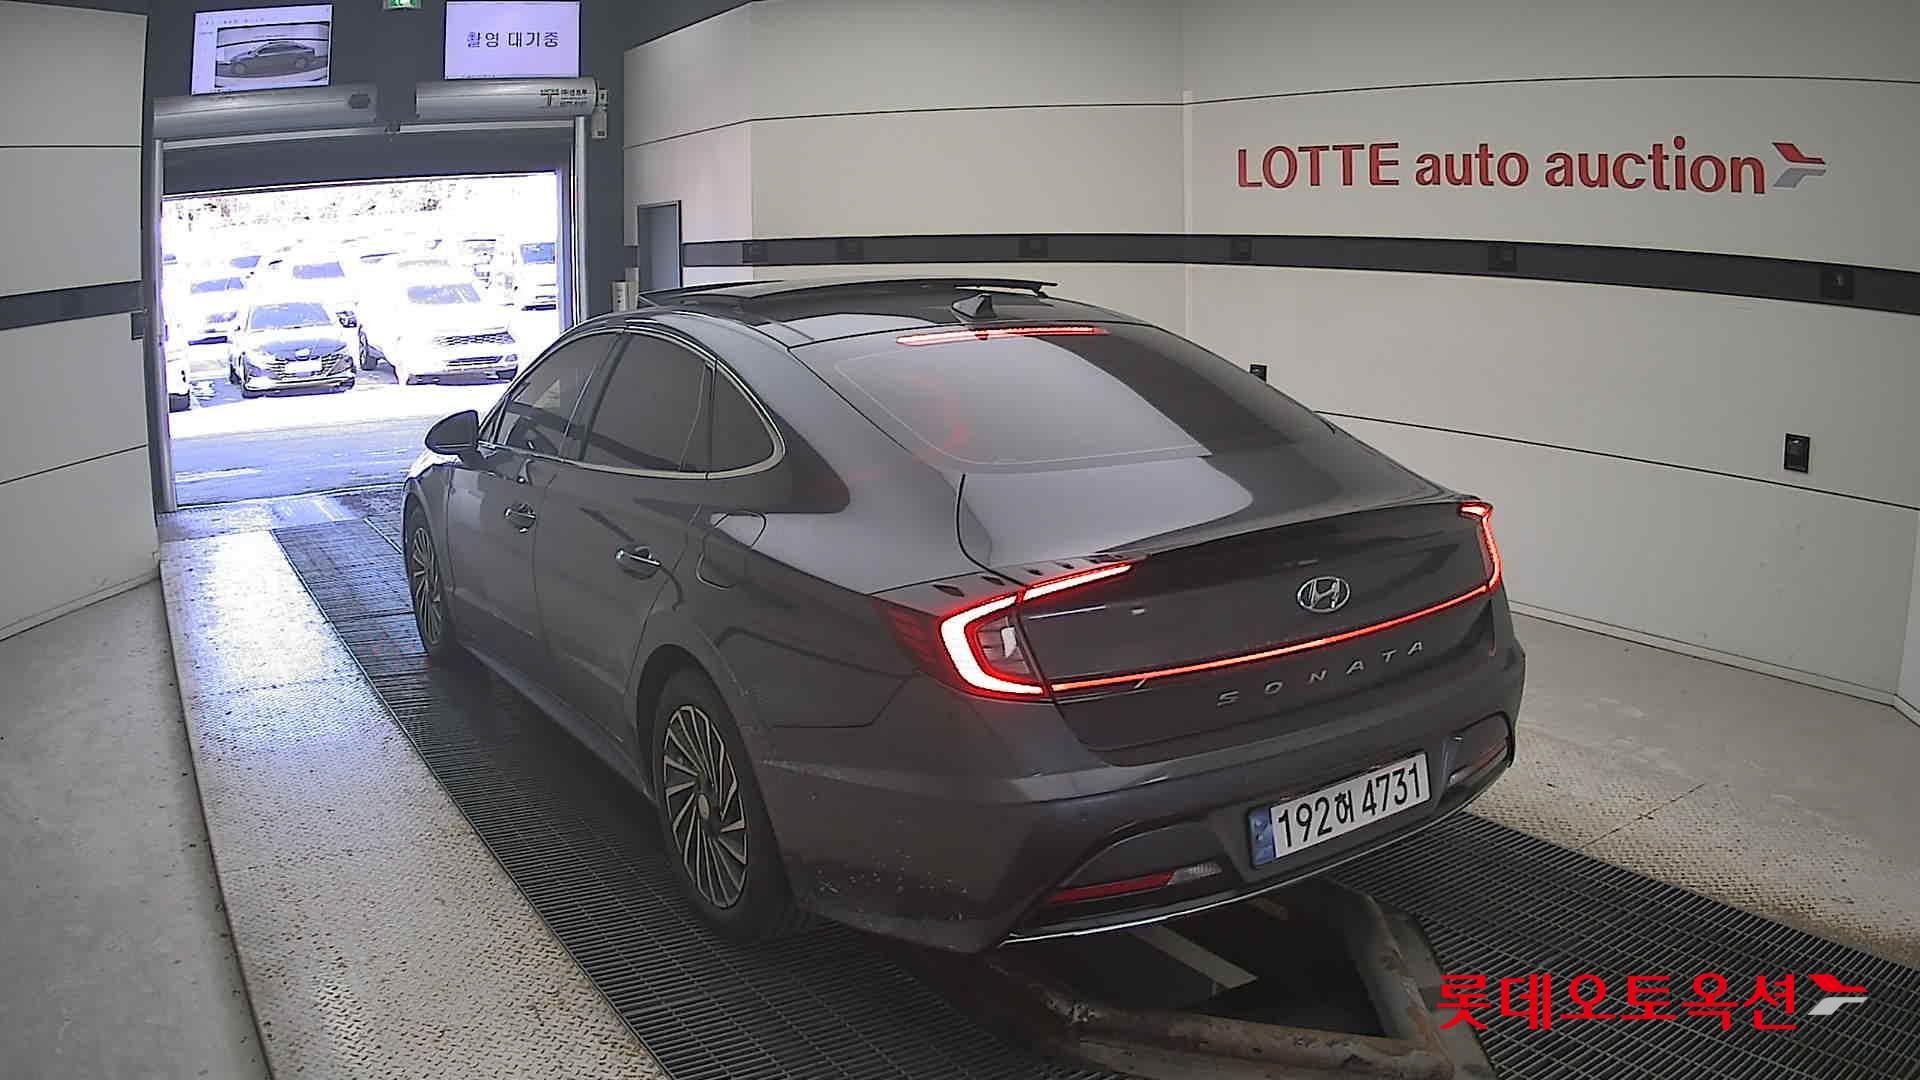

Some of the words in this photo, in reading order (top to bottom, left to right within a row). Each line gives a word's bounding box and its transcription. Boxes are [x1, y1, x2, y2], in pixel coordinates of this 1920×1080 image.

[507, 31, 560, 48] 대기중
[1237, 142, 1400, 188] LOTTE
[1416, 143, 1529, 186] auto
[1545, 136, 1766, 195] auction
[1217, 641, 1425, 706] SONATA
